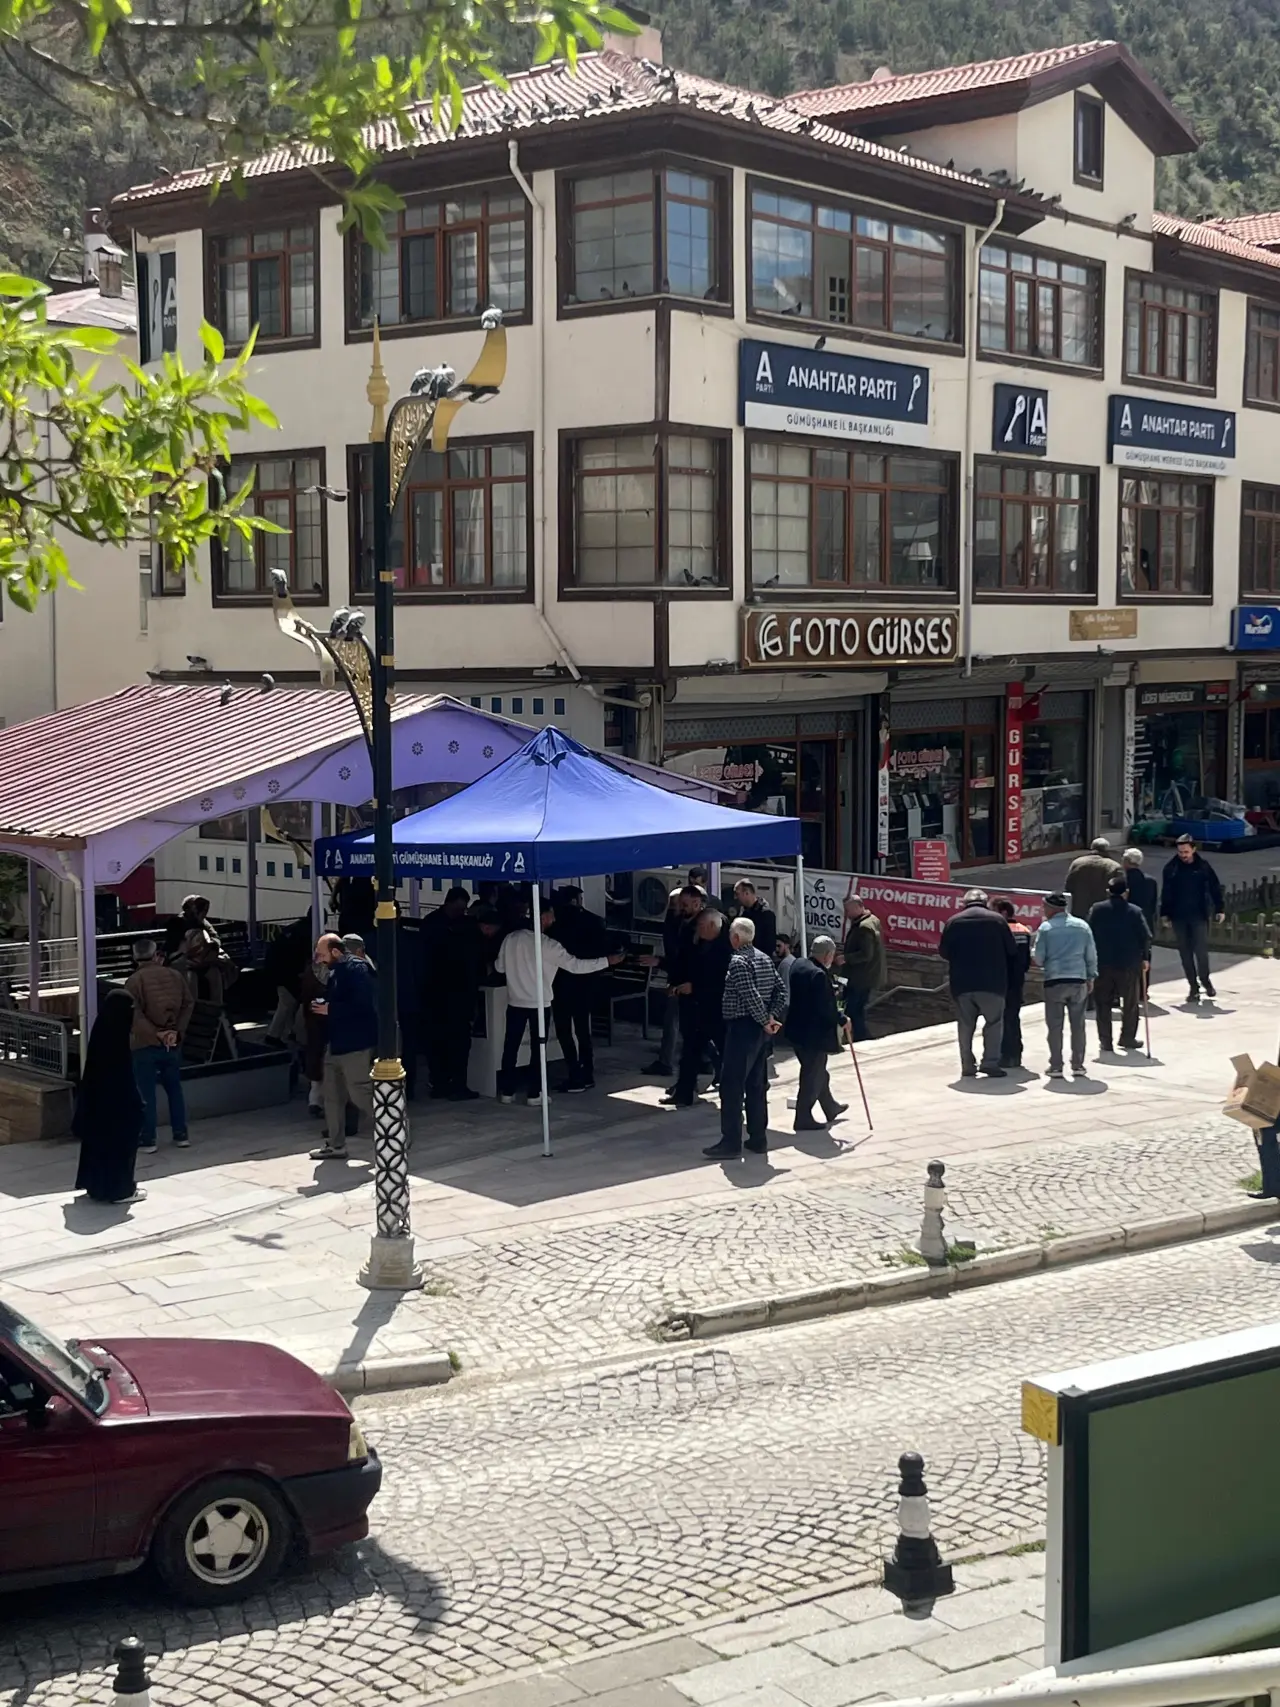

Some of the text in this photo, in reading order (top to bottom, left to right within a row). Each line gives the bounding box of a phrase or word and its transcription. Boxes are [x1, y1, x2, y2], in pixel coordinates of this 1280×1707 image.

[756, 350, 773, 383] A
[787, 365, 897, 401] ANAHTAR PARTİ
[786, 412, 895, 437] GÜMÜŞHANE İL BAŞKANLIĞI
[1030, 397, 1046, 434] A
[1120, 403, 1132, 430] A
[1141, 413, 1188, 437] ANAHTAR
[789, 617, 860, 656] FOTO
[867, 617, 952, 656] GÜRSES
[1007, 729, 1021, 855] GÜRSES
[349, 853, 376, 865] ANAHTA
[399, 850, 442, 868] GÜMÜŞHANE
[442, 851, 450, 866] İL
[450, 853, 494, 870] BAŞKANLIĞI
[514, 851, 525, 868] A
[803, 894, 836, 911] FOTO
[860, 886, 952, 909] BİYOMETRİK
[804, 911, 842, 929] ÜRSES
[886, 914, 935, 931] ÇEKİM
